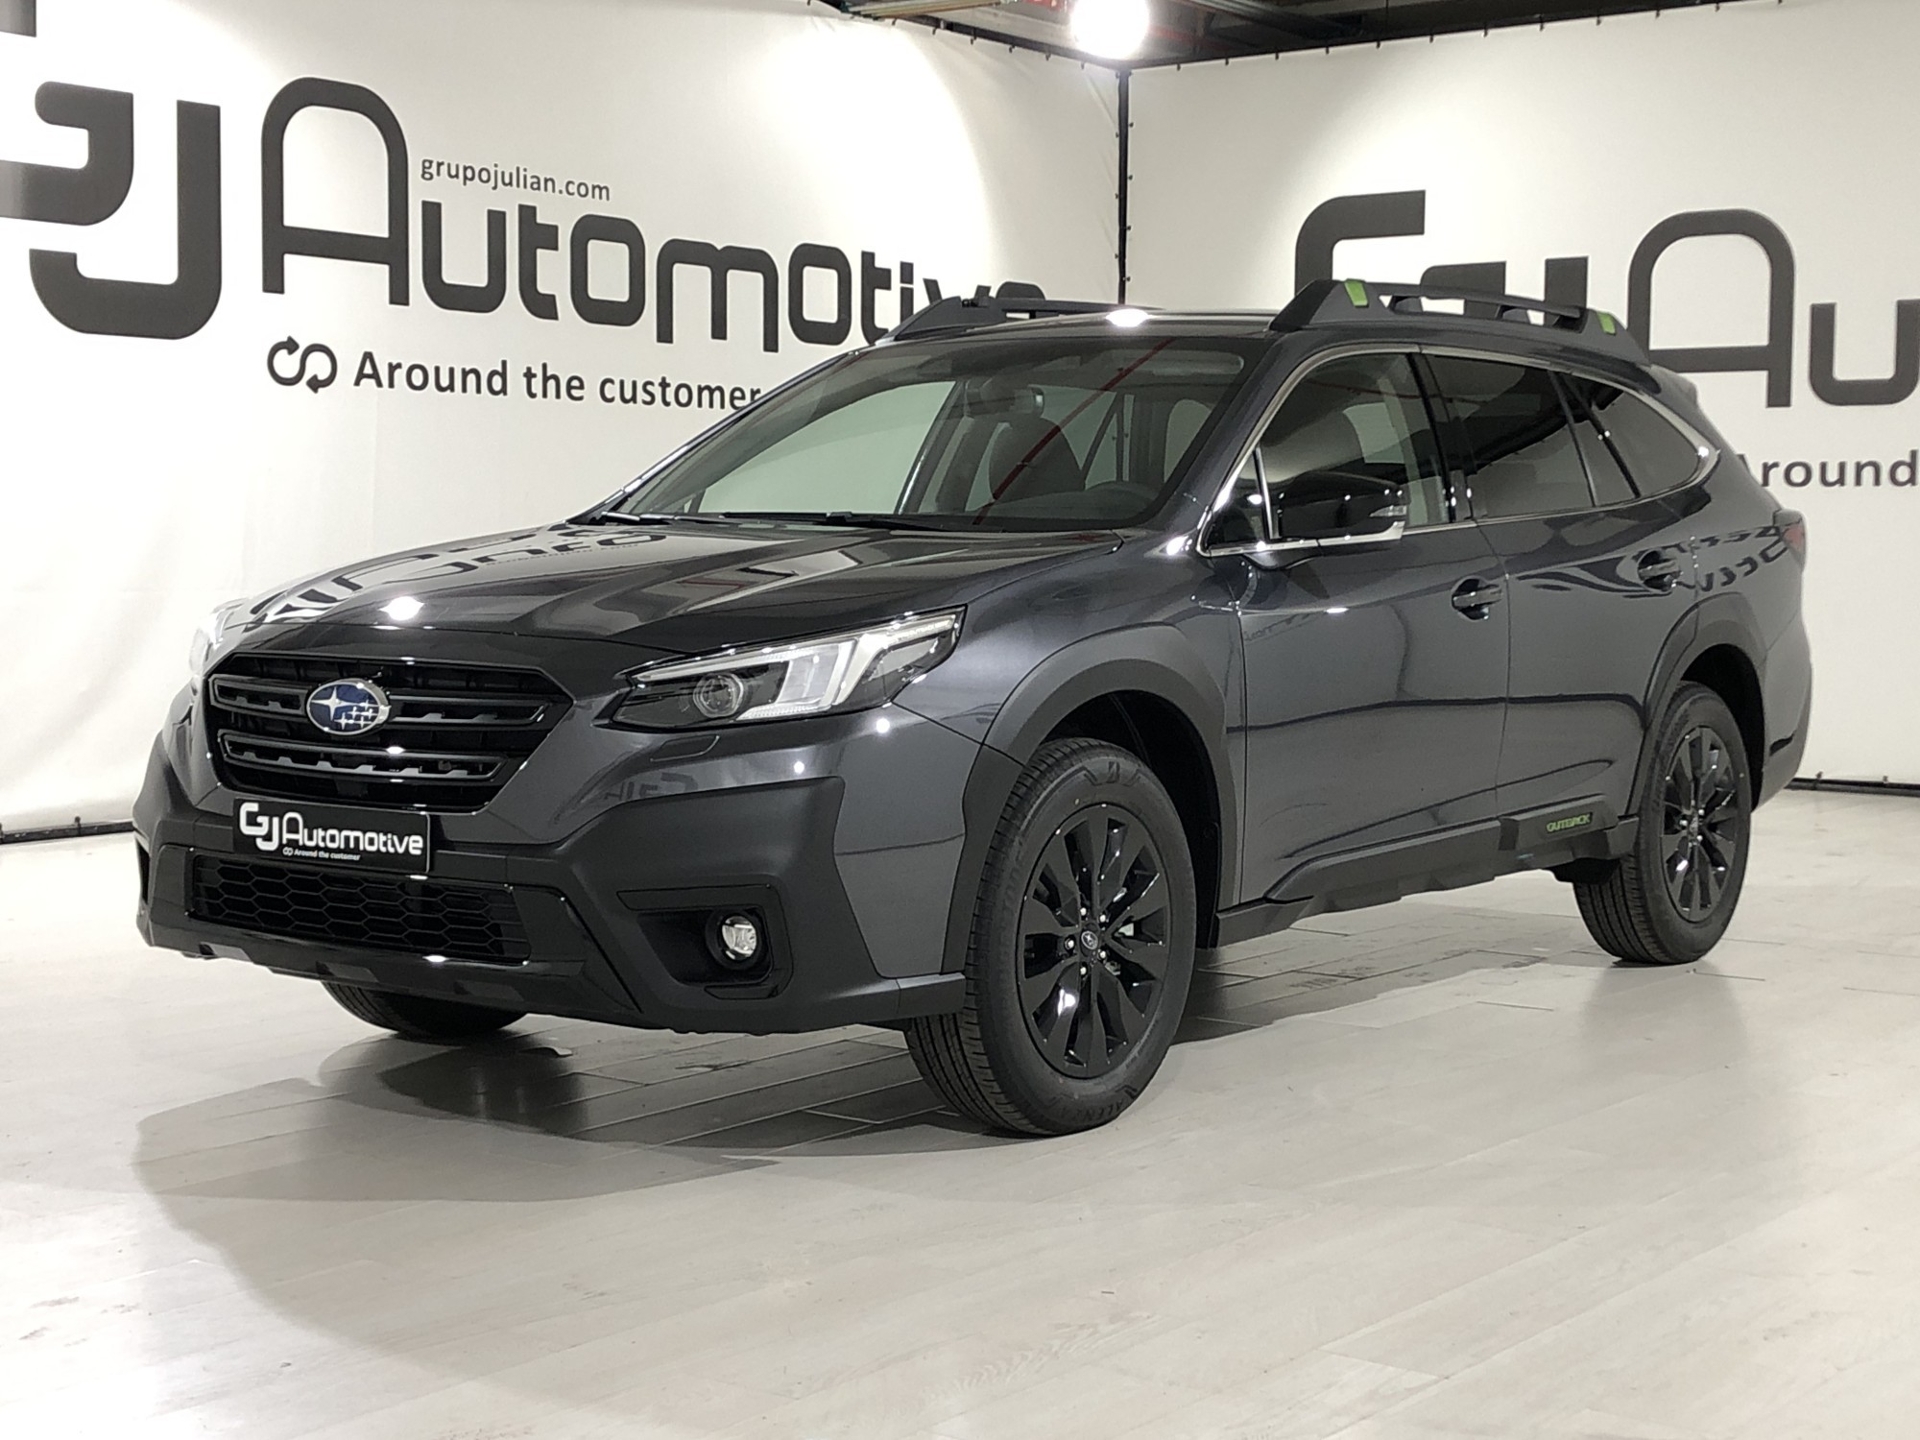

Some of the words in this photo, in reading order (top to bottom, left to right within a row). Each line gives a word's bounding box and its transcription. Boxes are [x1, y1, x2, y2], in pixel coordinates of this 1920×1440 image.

[420, 158, 610, 202] grupojulian.com
[261, 77, 1047, 353] Automoti
[353, 350, 508, 397] Around
[523, 362, 586, 402] the
[599, 375, 762, 411] customer
[1736, 449, 1919, 488] round
[282, 812, 423, 855] Automotive
